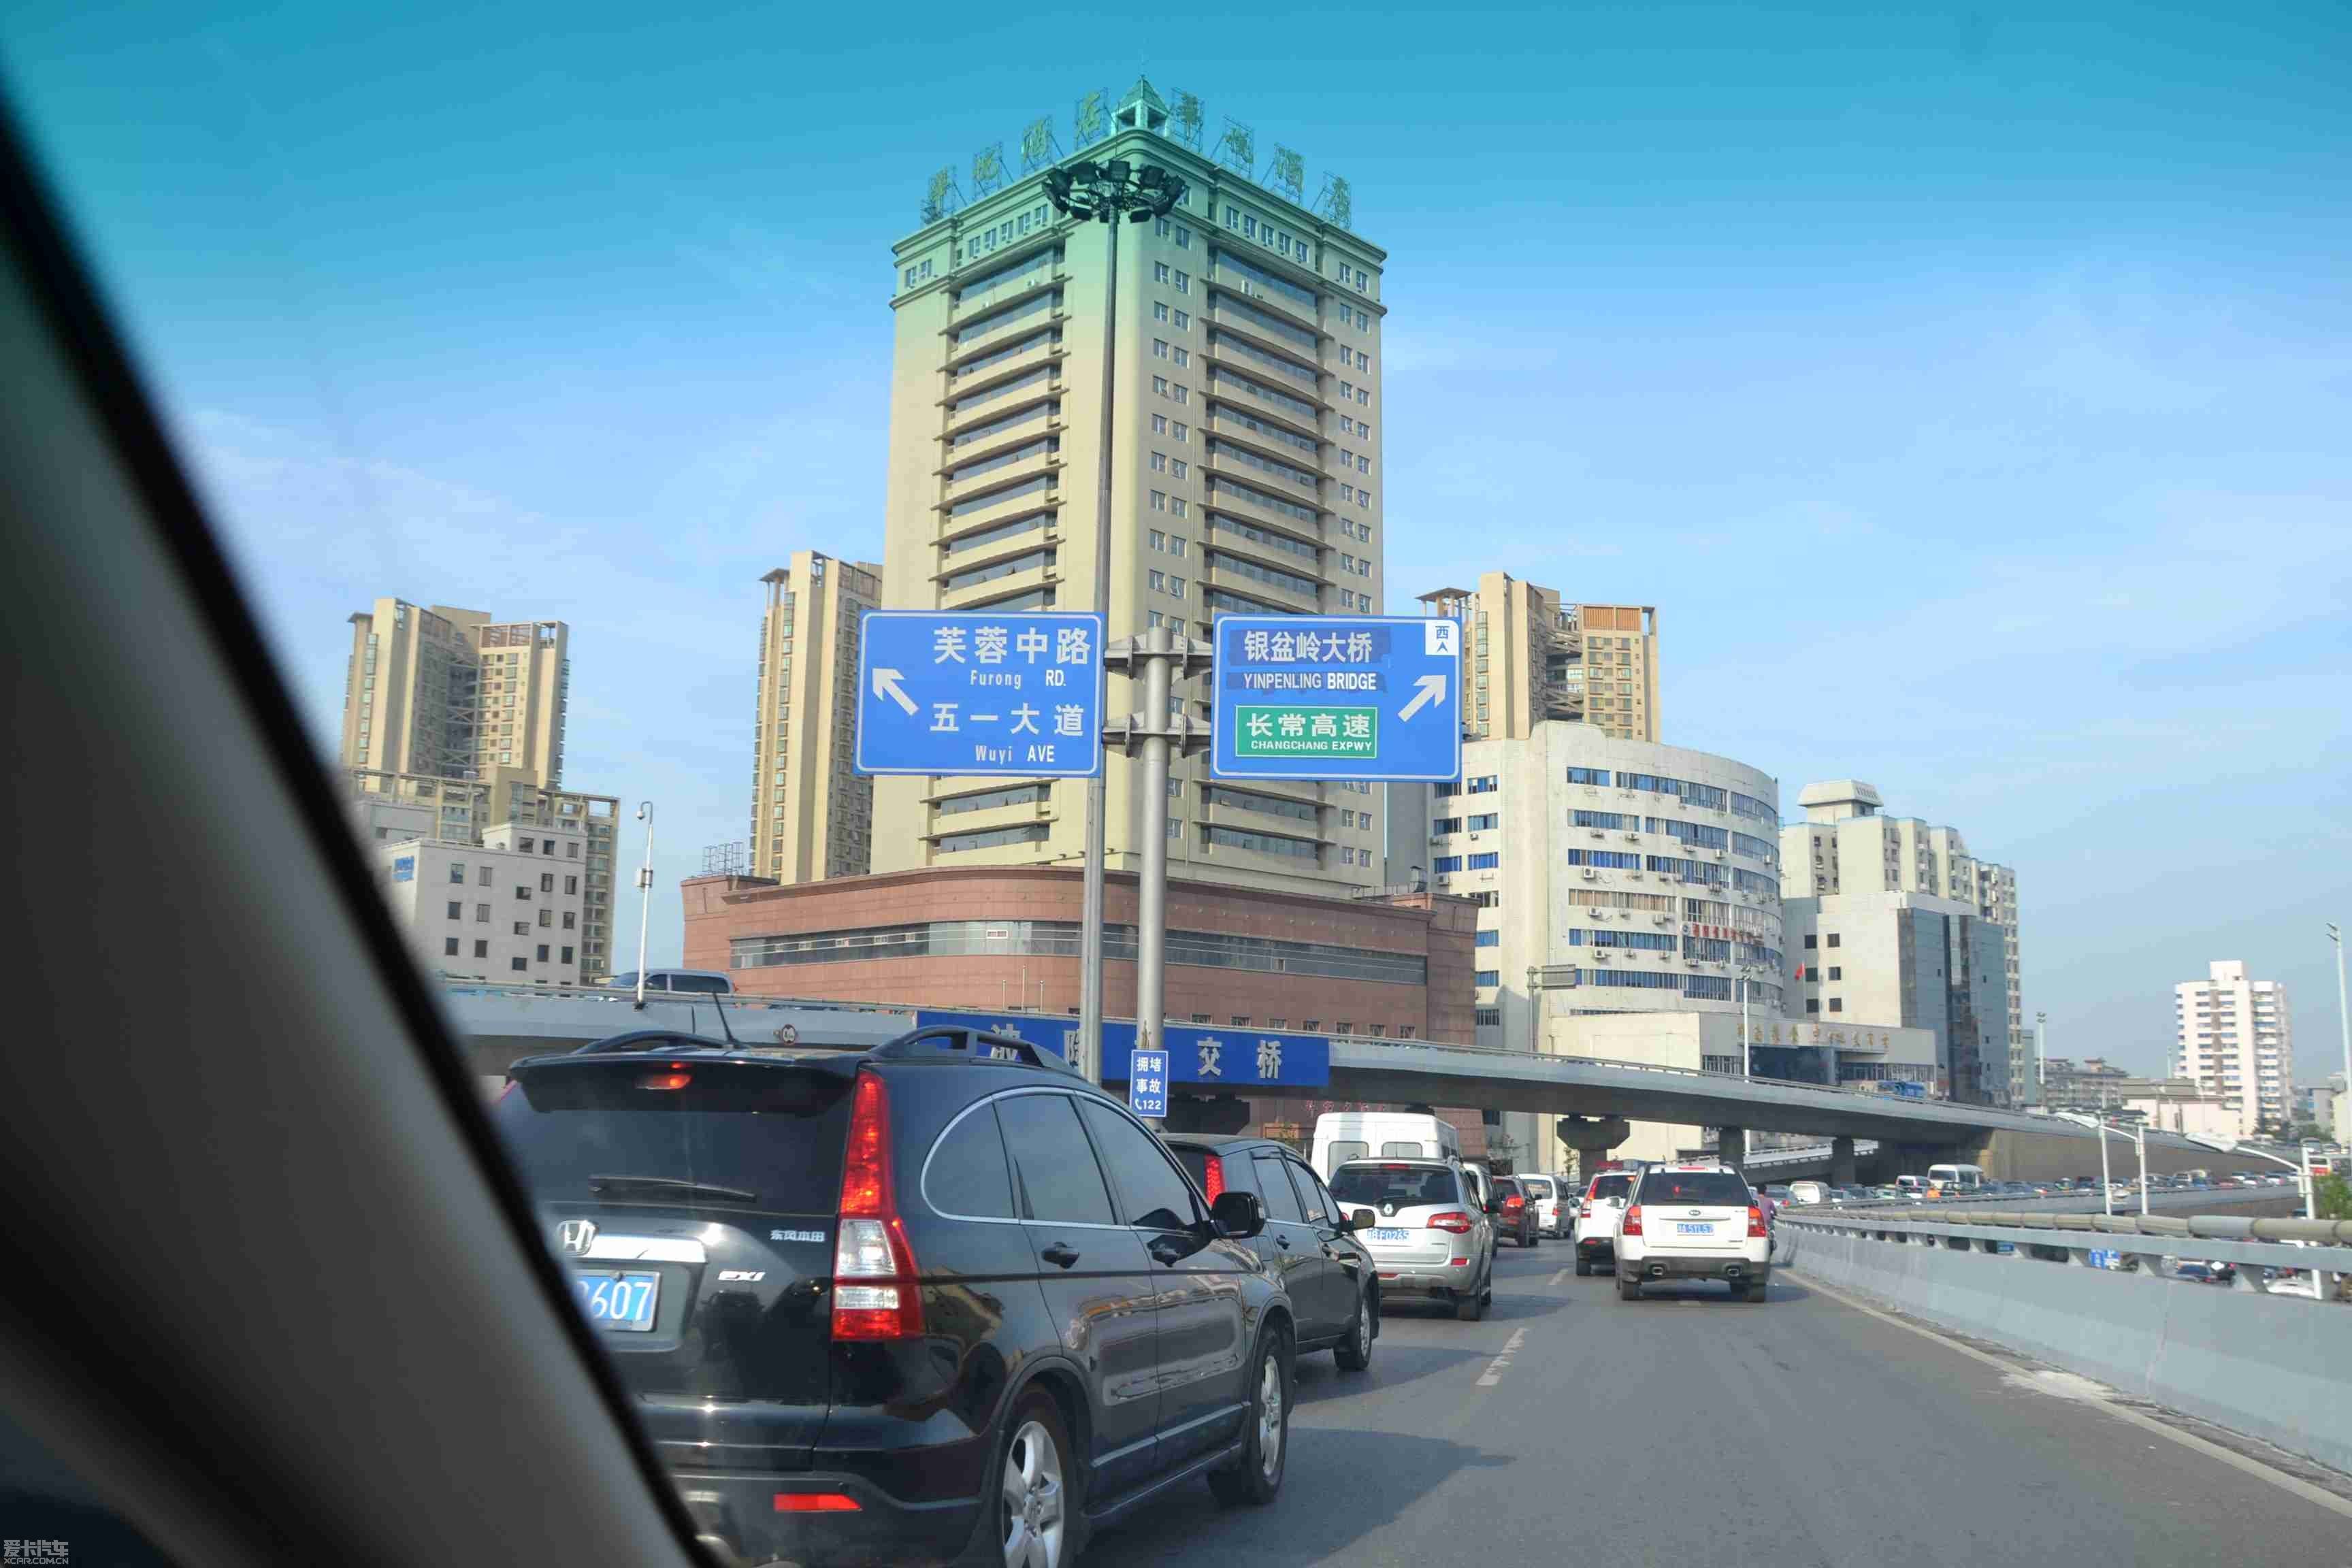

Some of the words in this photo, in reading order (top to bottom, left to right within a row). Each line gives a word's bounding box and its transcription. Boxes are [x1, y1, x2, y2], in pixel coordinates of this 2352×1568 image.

[1435, 625, 1450, 640] 西
[934, 627, 1090, 665] 芙蓉中路
[1244, 631, 1372, 663] 银盆岭大桥
[970, 670, 1022, 689] Furong
[1244, 673, 1322, 689] YINPENLING
[1327, 672, 1377, 690] BRIDGE
[930, 702, 1084, 736] 五一大道
[1247, 713, 1371, 738] 长常高速
[975, 745, 1013, 764] Wuyi
[1027, 745, 1055, 762] AVE
[1251, 740, 1328, 751] CHANGCHANG
[1332, 741, 1372, 751] EXPWY
[1137, 1056, 1162, 1072] 拥堵
[1137, 1078, 1161, 1094] 事故
[1143, 1100, 1162, 1110] 122
[770, 1229, 826, 1242] 东风本田
